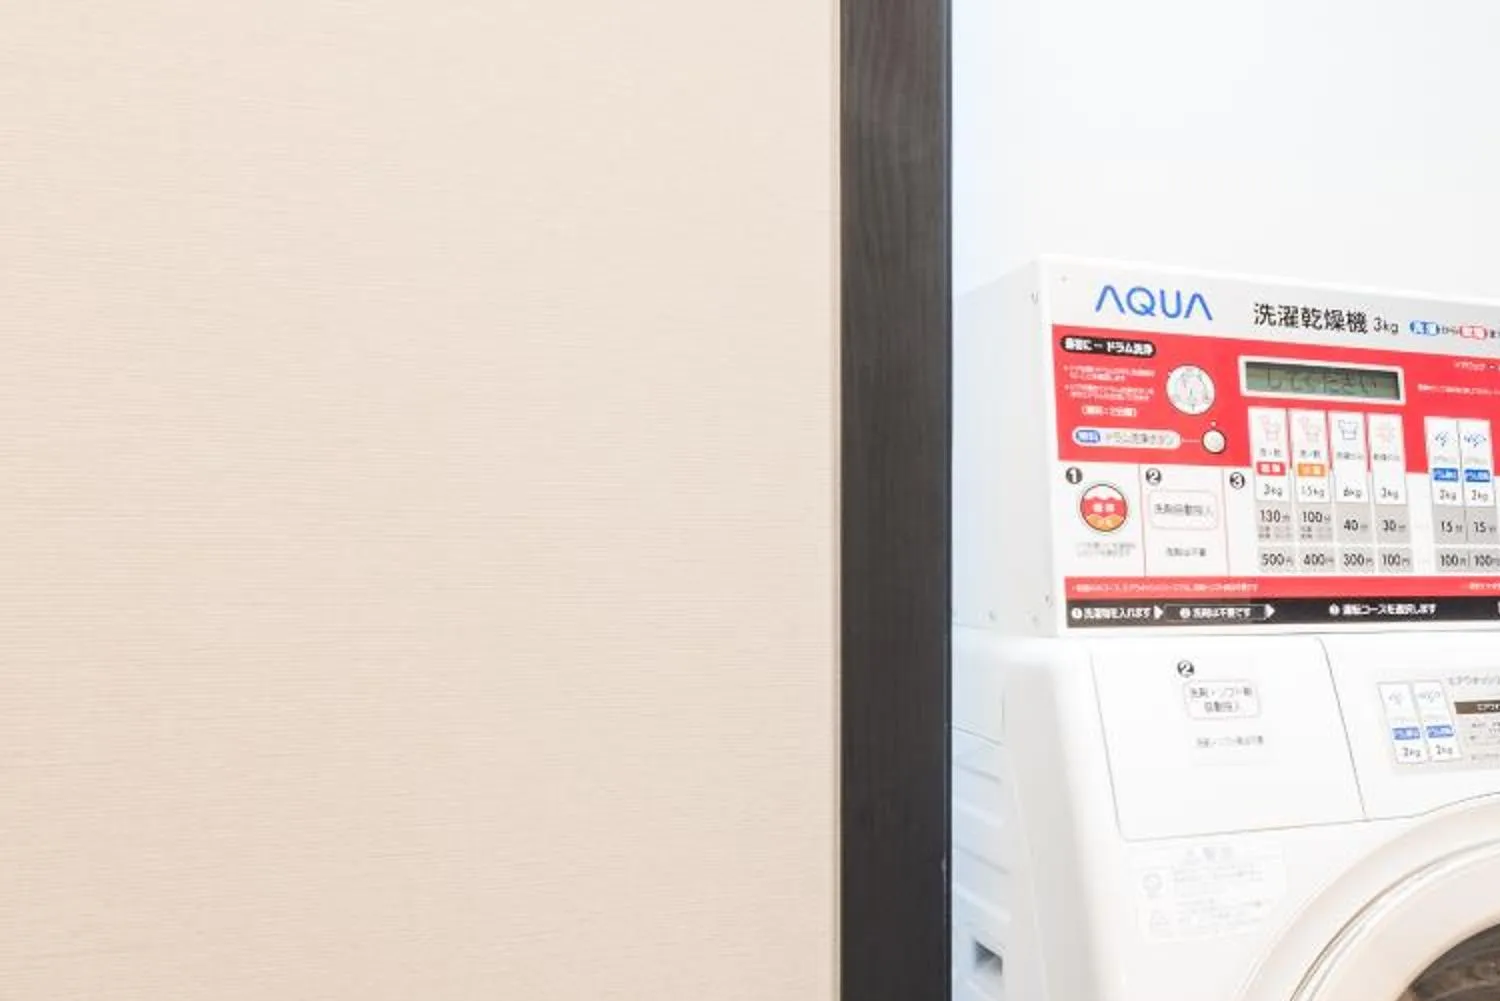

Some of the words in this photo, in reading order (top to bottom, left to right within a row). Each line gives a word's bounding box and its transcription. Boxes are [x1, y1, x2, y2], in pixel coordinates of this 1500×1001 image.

[1095, 284, 1213, 321] AQUA
[1254, 302, 1369, 334] 洗濯乾燥機
[1373, 316, 1400, 334] 3kg
